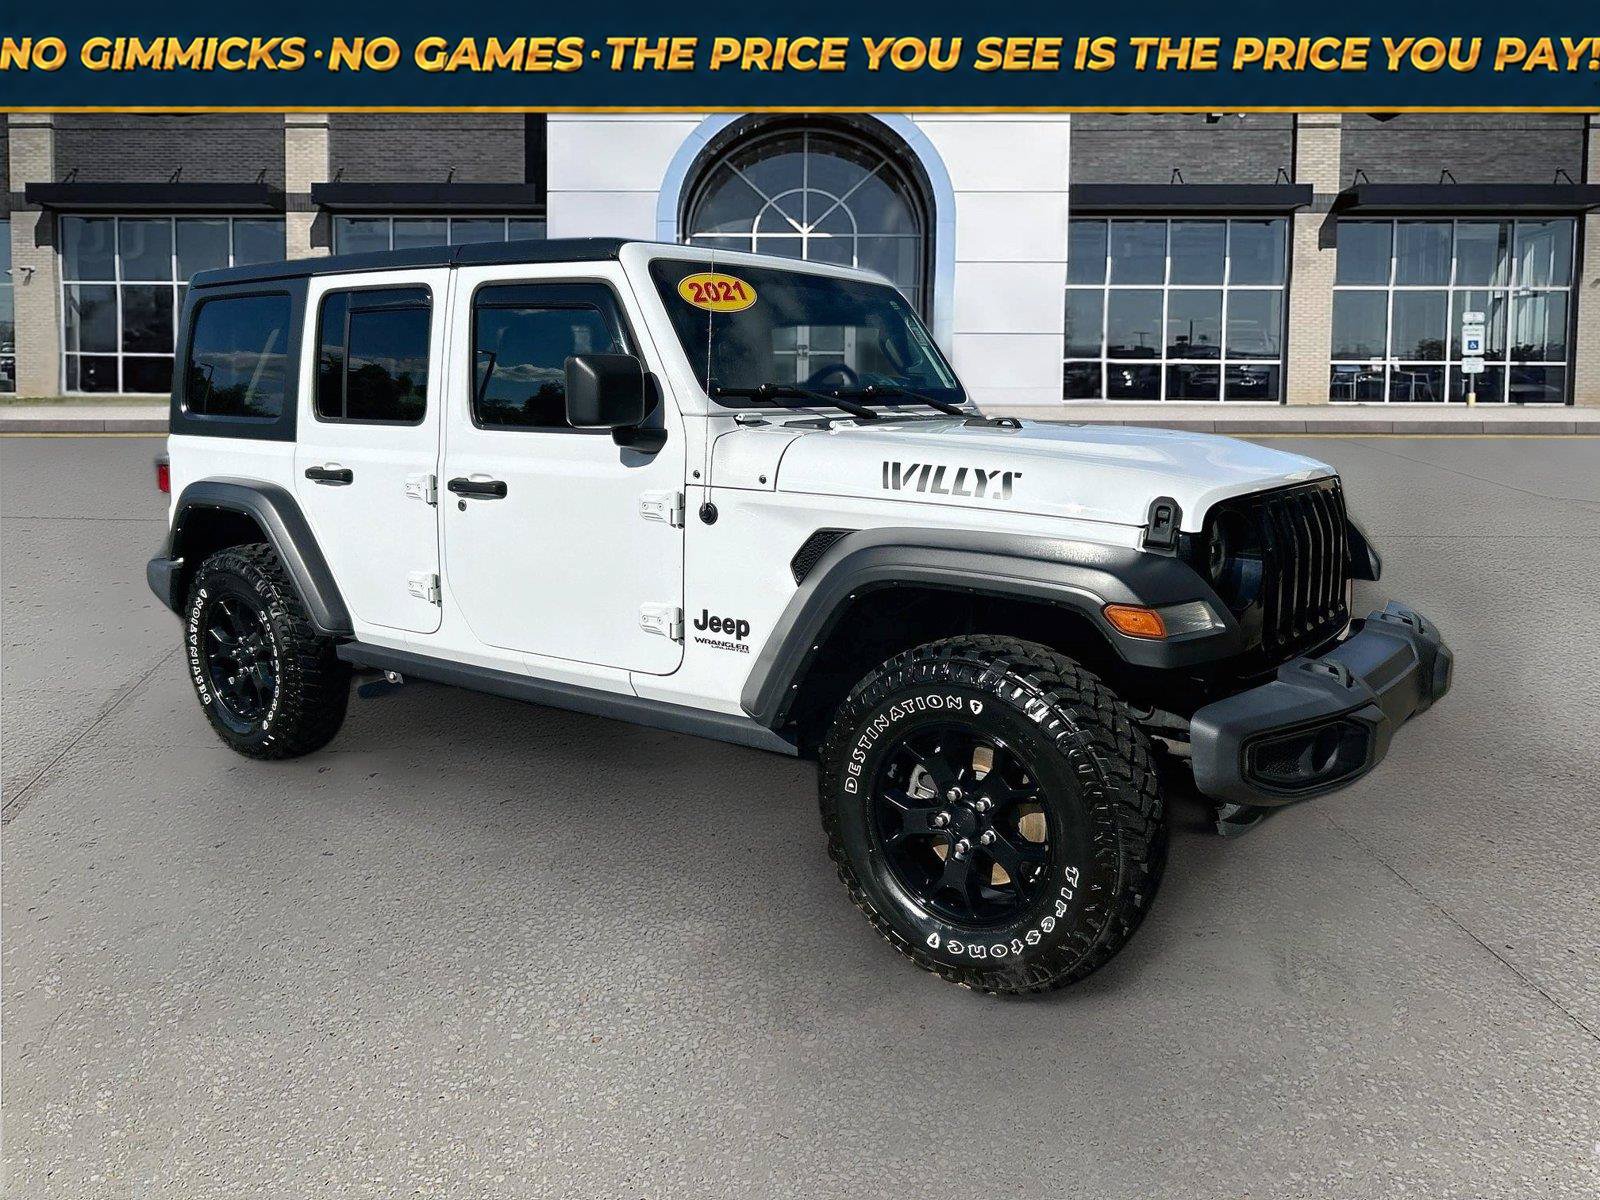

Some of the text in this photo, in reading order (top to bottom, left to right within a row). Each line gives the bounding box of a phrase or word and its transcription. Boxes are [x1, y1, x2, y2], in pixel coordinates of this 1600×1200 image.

[688, 280, 748, 302] 2021
[882, 461, 1023, 500] WILLYS
[693, 609, 750, 641] Jeep
[694, 636, 750, 652] WRANGLER
[844, 693, 963, 795] DESTINATION
[946, 865, 1080, 959] Firestone
